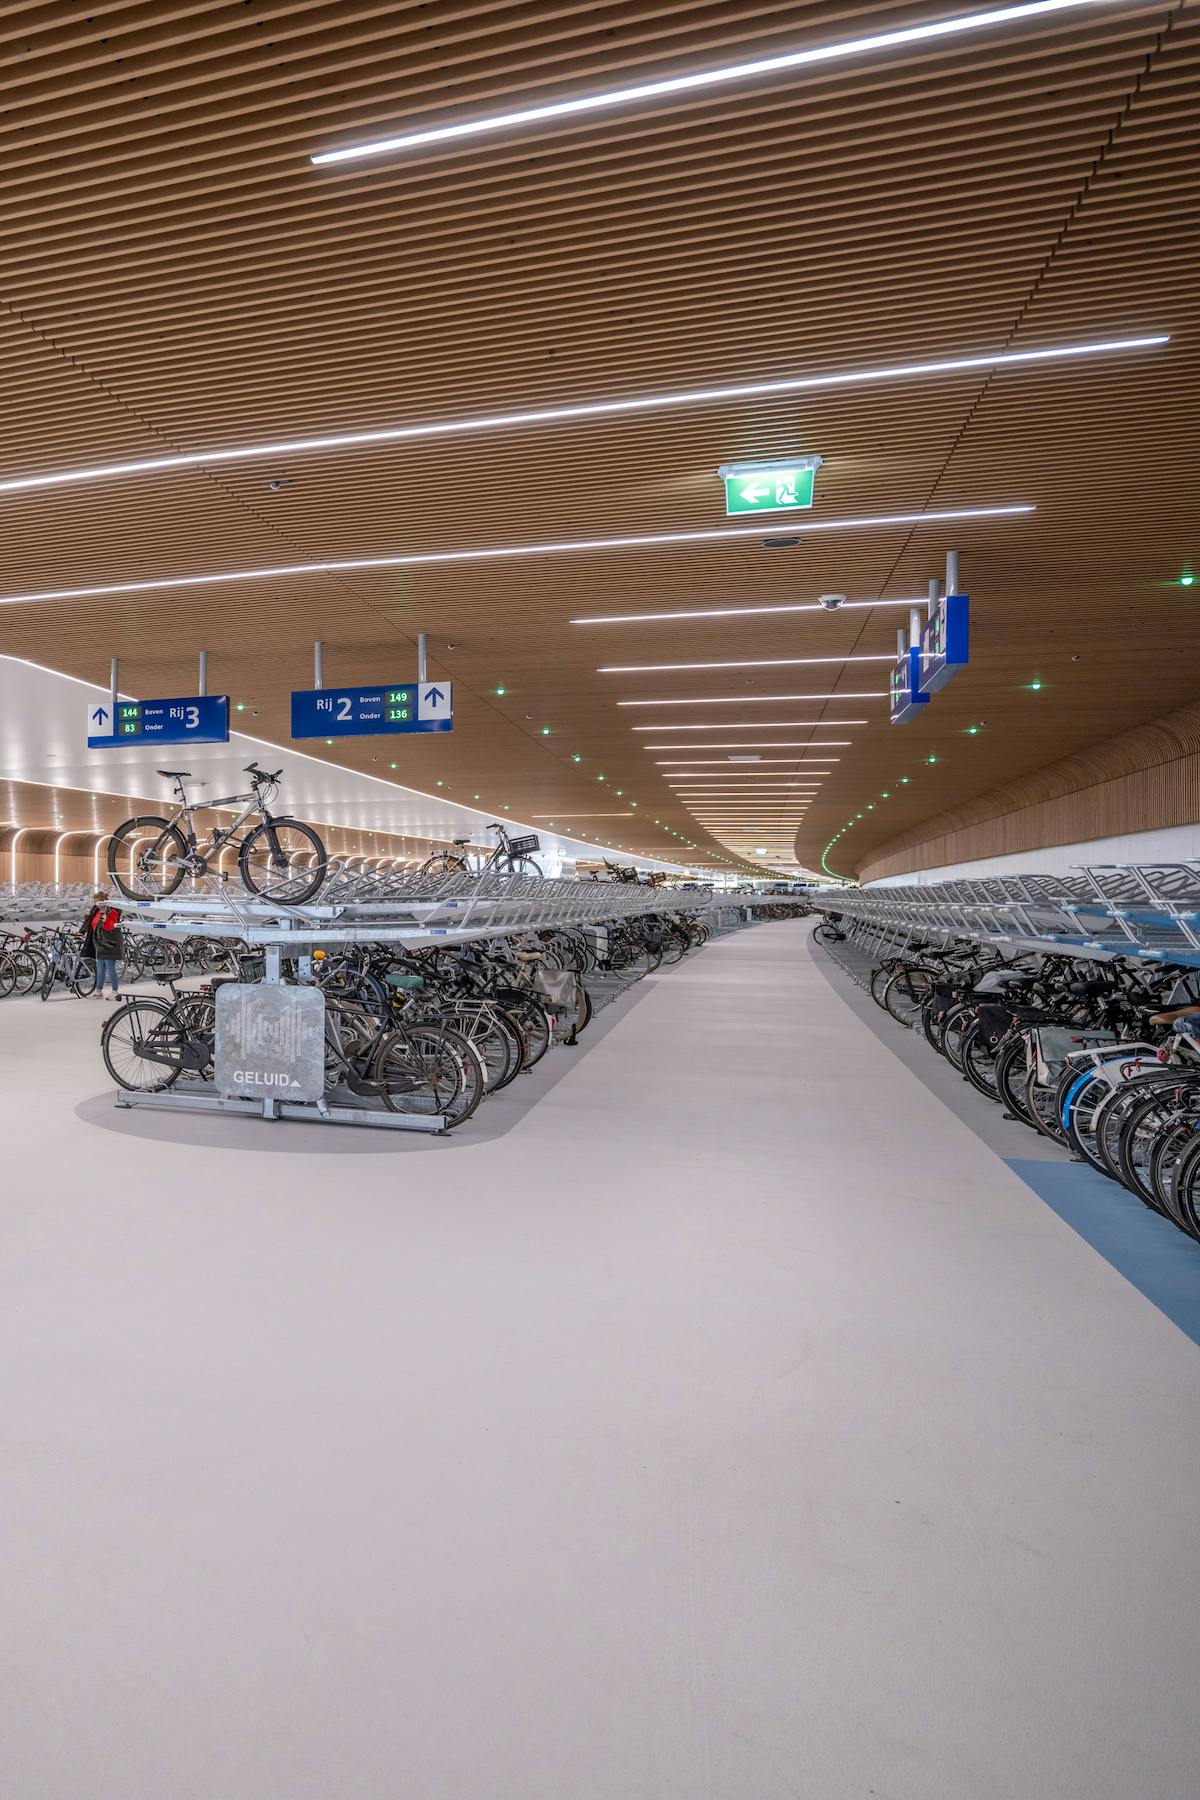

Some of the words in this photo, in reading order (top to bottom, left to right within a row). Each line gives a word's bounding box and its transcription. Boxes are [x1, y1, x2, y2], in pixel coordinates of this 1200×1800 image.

[359, 696, 381, 704] Boven
[390, 693, 408, 702] 149
[123, 708, 138, 717] 144
[316, 698, 333, 711] Rij
[336, 697, 353, 721] 2
[169, 707, 185, 720] Rij
[185, 706, 200, 729] 3
[359, 712, 381, 720] Onder
[390, 710, 408, 719] 136
[125, 724, 135, 733] 83
[144, 723, 164, 731] Onder
[233, 1070, 289, 1086] GELUID
